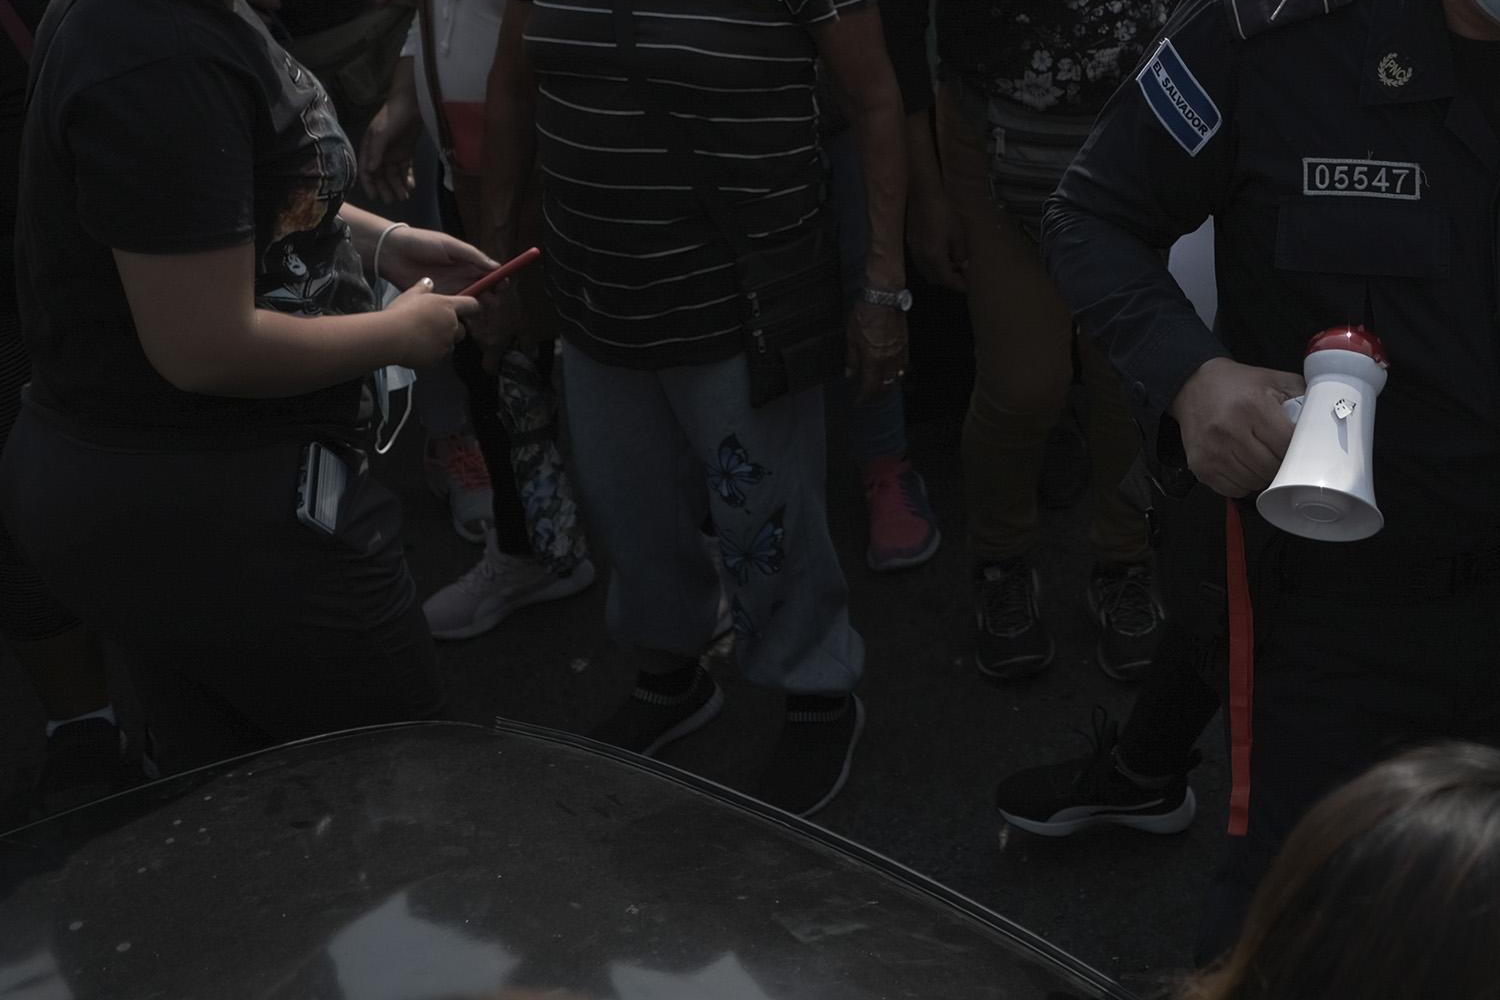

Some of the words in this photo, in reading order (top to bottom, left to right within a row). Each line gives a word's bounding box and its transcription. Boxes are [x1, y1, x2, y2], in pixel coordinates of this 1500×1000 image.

[1153, 61, 1163, 77] EL
[1162, 77, 1209, 136] SALVADOR
[1315, 164, 1410, 194] 05547
